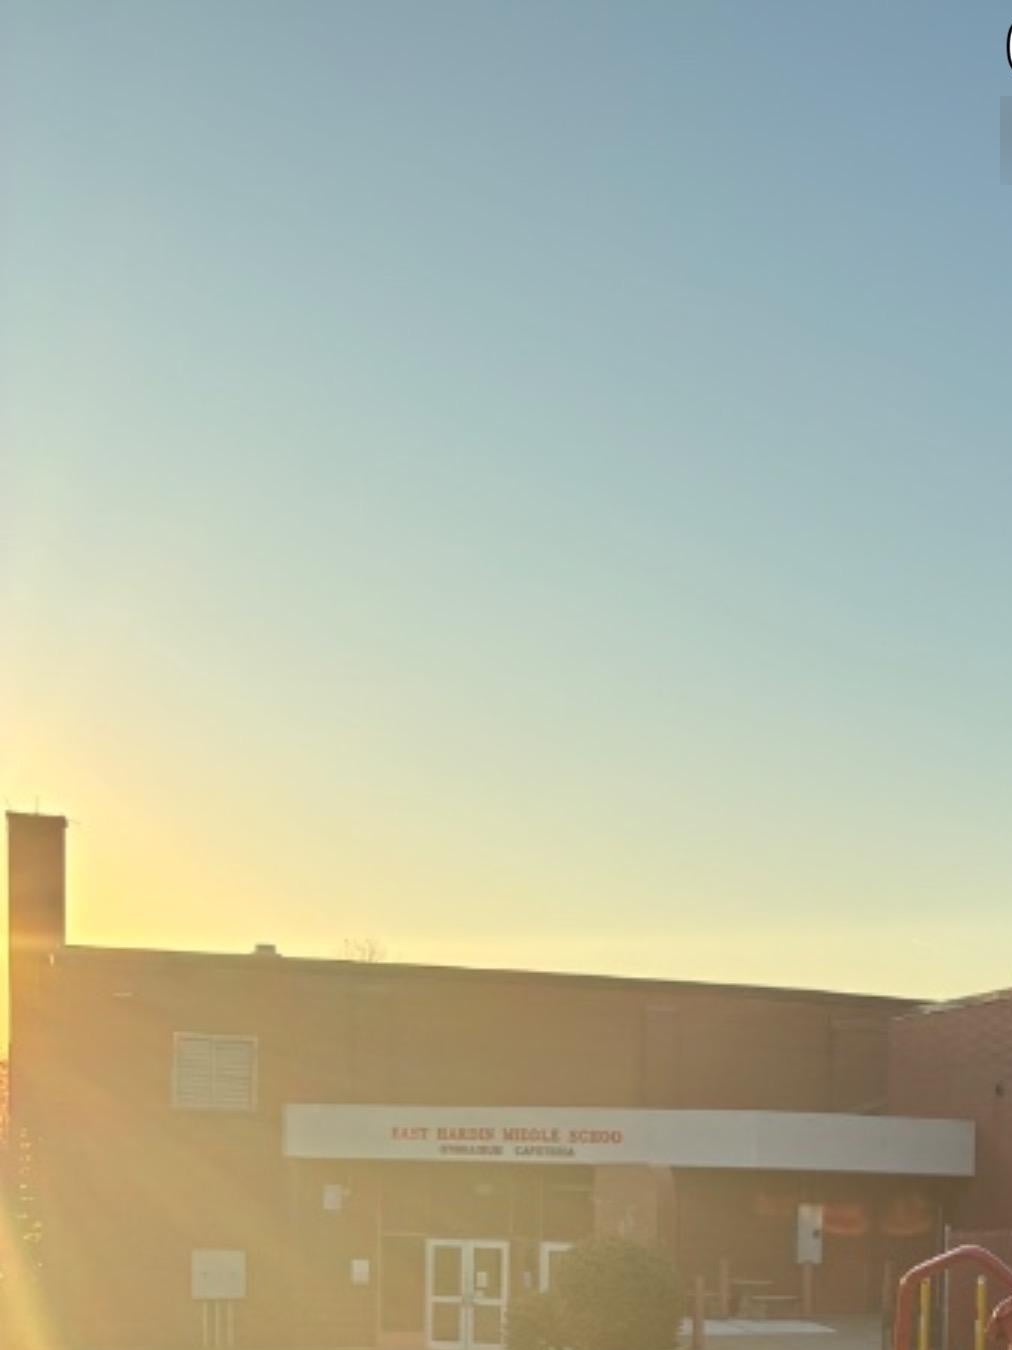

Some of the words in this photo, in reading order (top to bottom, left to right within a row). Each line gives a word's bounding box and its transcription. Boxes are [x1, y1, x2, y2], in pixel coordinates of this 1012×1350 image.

[392, 1127, 429, 1141] EAST
[437, 1128, 496, 1141] HARDIN
[504, 1127, 560, 1142] MIDDLE
